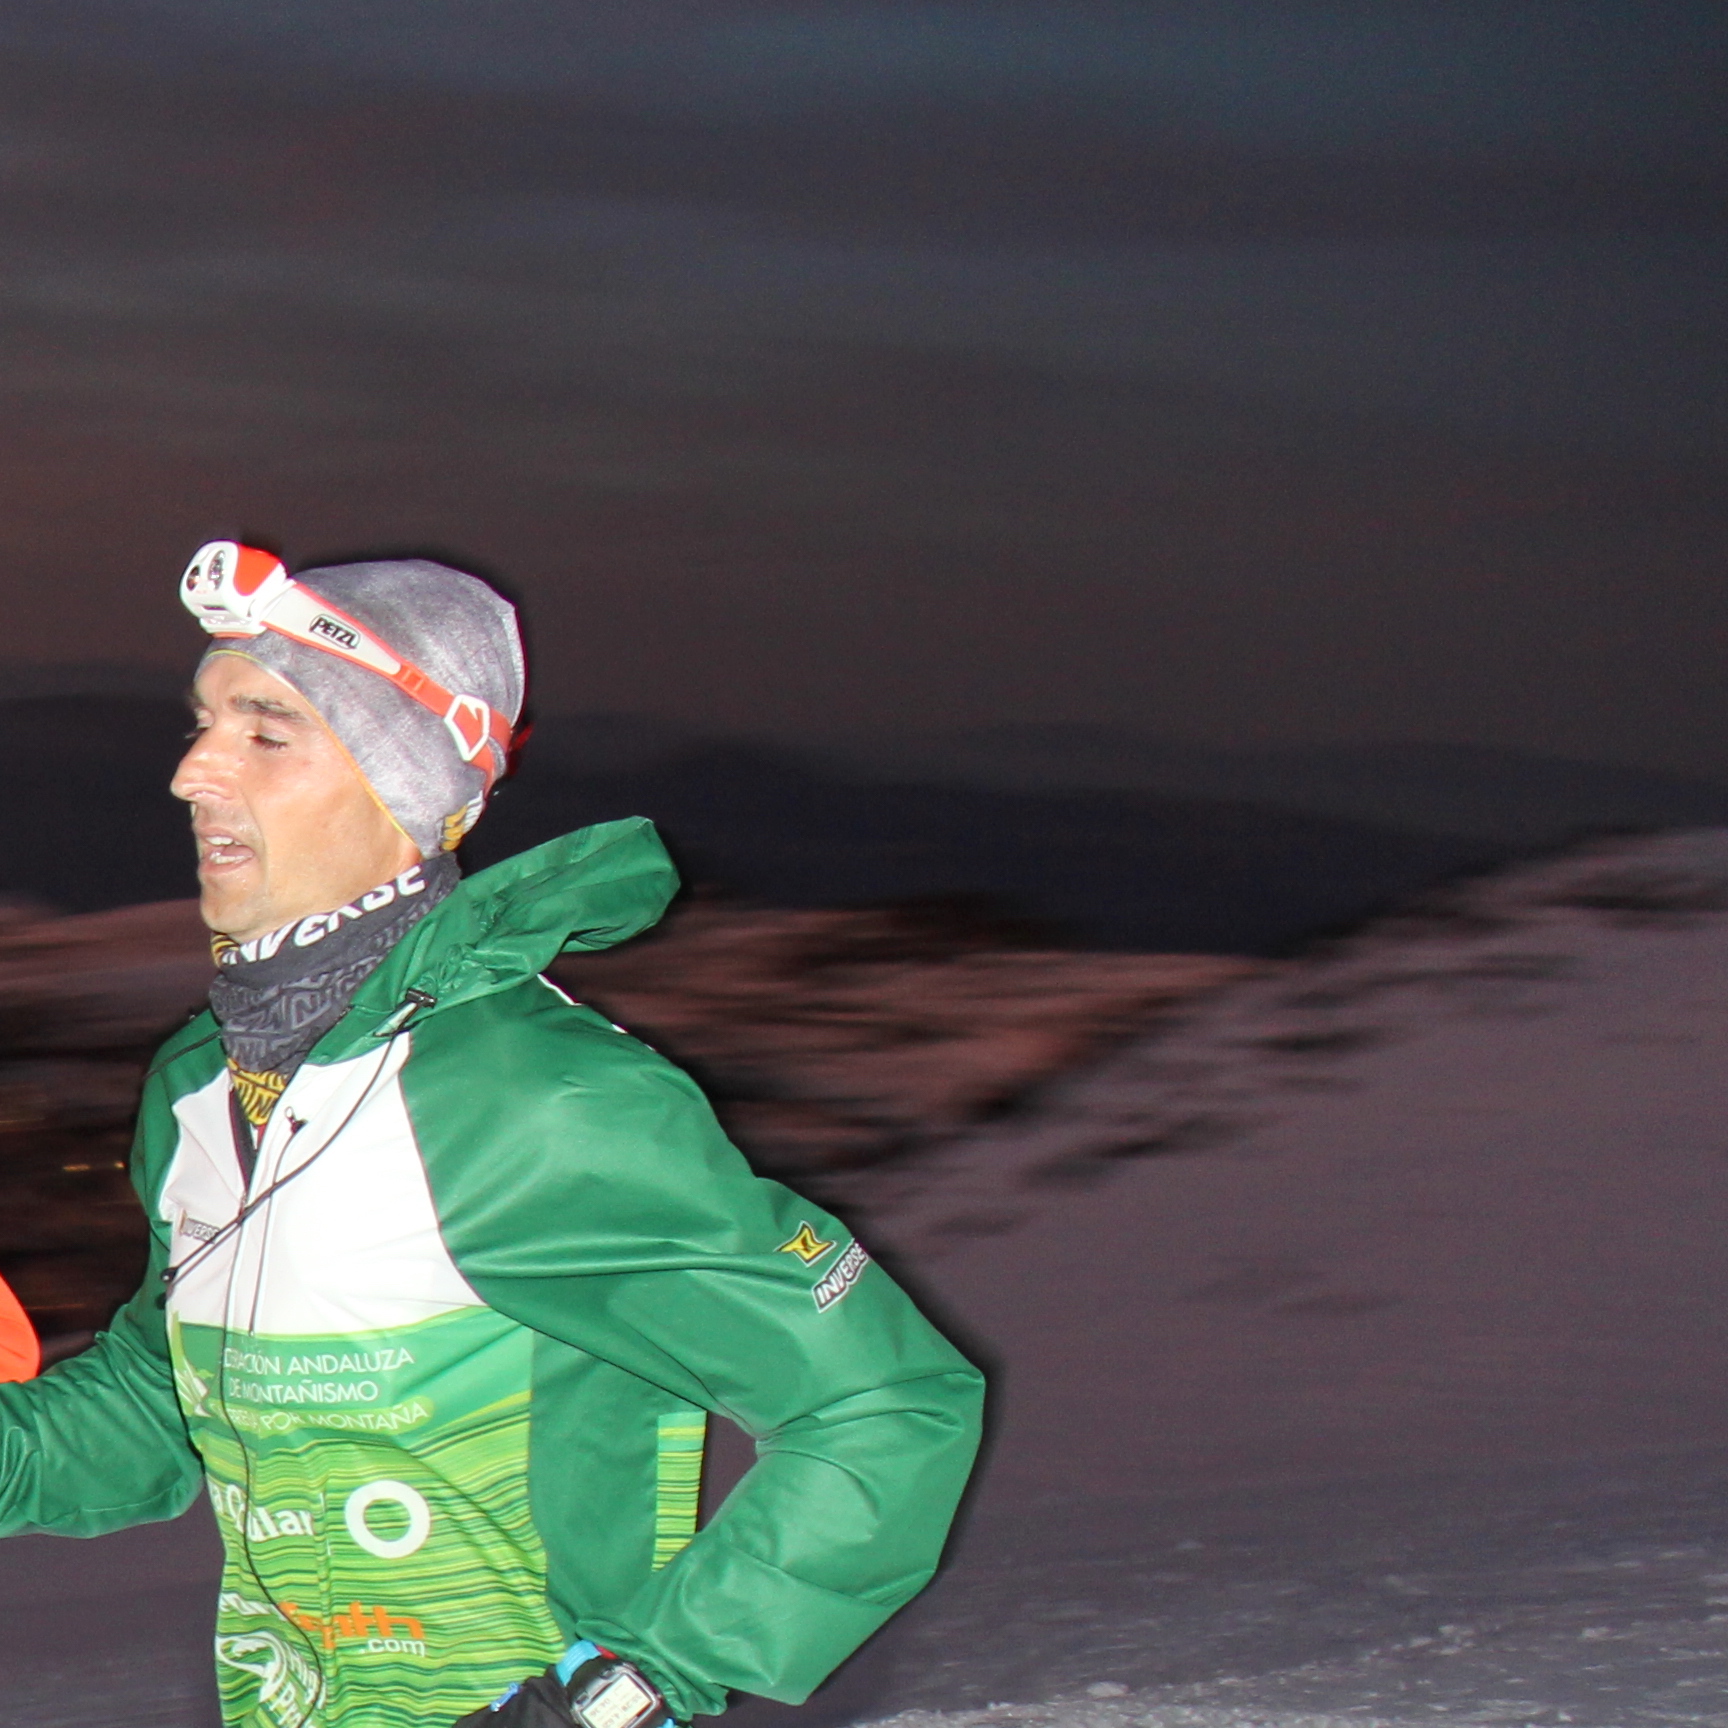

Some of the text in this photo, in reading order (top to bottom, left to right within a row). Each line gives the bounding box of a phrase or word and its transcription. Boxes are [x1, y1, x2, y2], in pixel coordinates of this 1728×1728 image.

[308, 616, 357, 650] PETZL
[287, 1347, 414, 1376] ANDALUZA
[243, 1379, 379, 1404] MONTAÑISMO
[306, 1401, 429, 1431] MONTAÑA
[359, 1638, 425, 1658] .com
